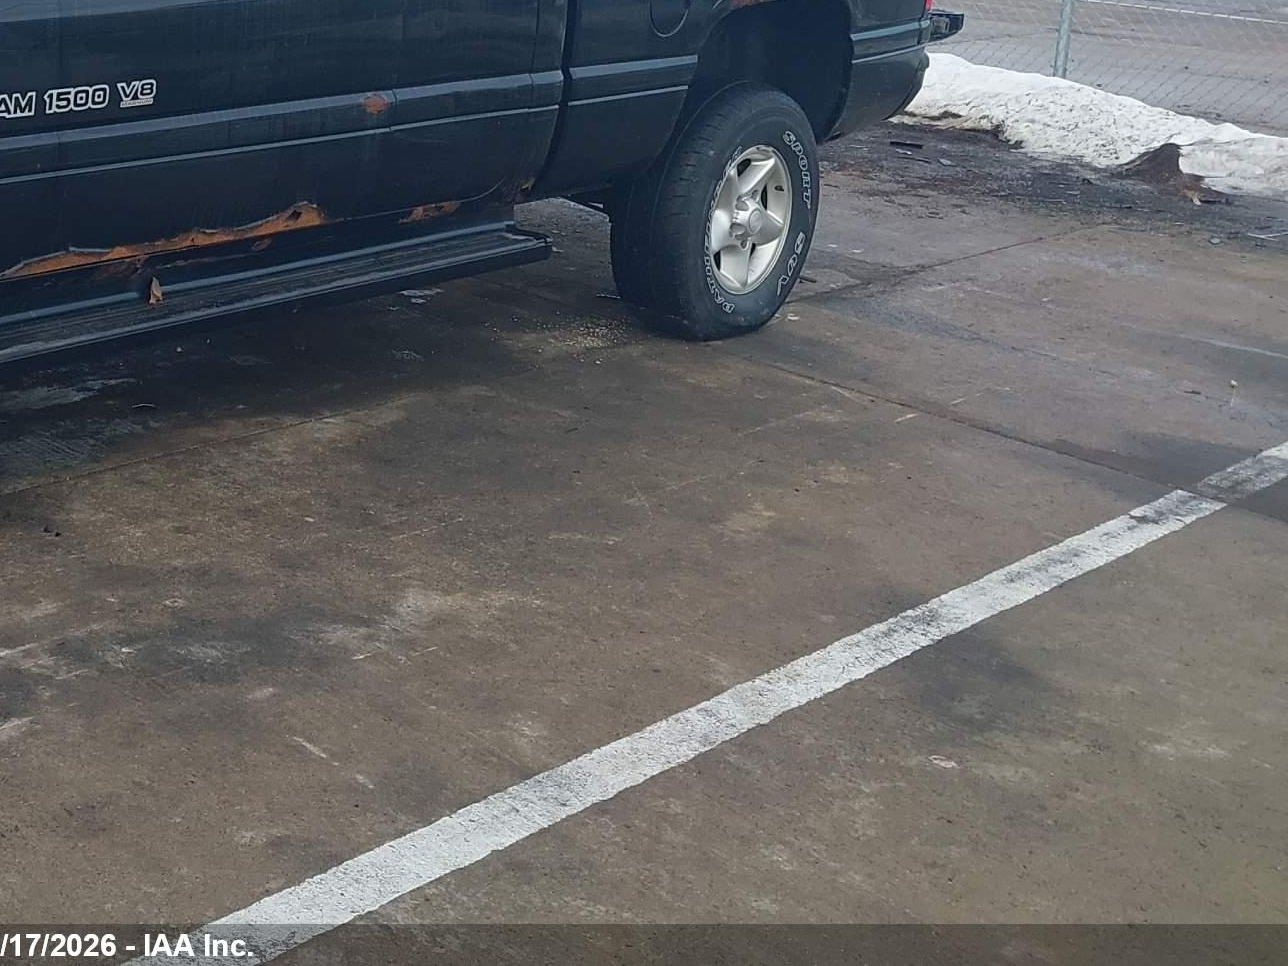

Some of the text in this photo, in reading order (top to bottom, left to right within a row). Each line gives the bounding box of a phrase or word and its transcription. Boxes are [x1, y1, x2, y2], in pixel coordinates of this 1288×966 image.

[44, 84, 109, 114] 1500
[116, 79, 157, 102] V8
[782, 130, 812, 209] SPORT
[776, 231, 806, 296] SUV
